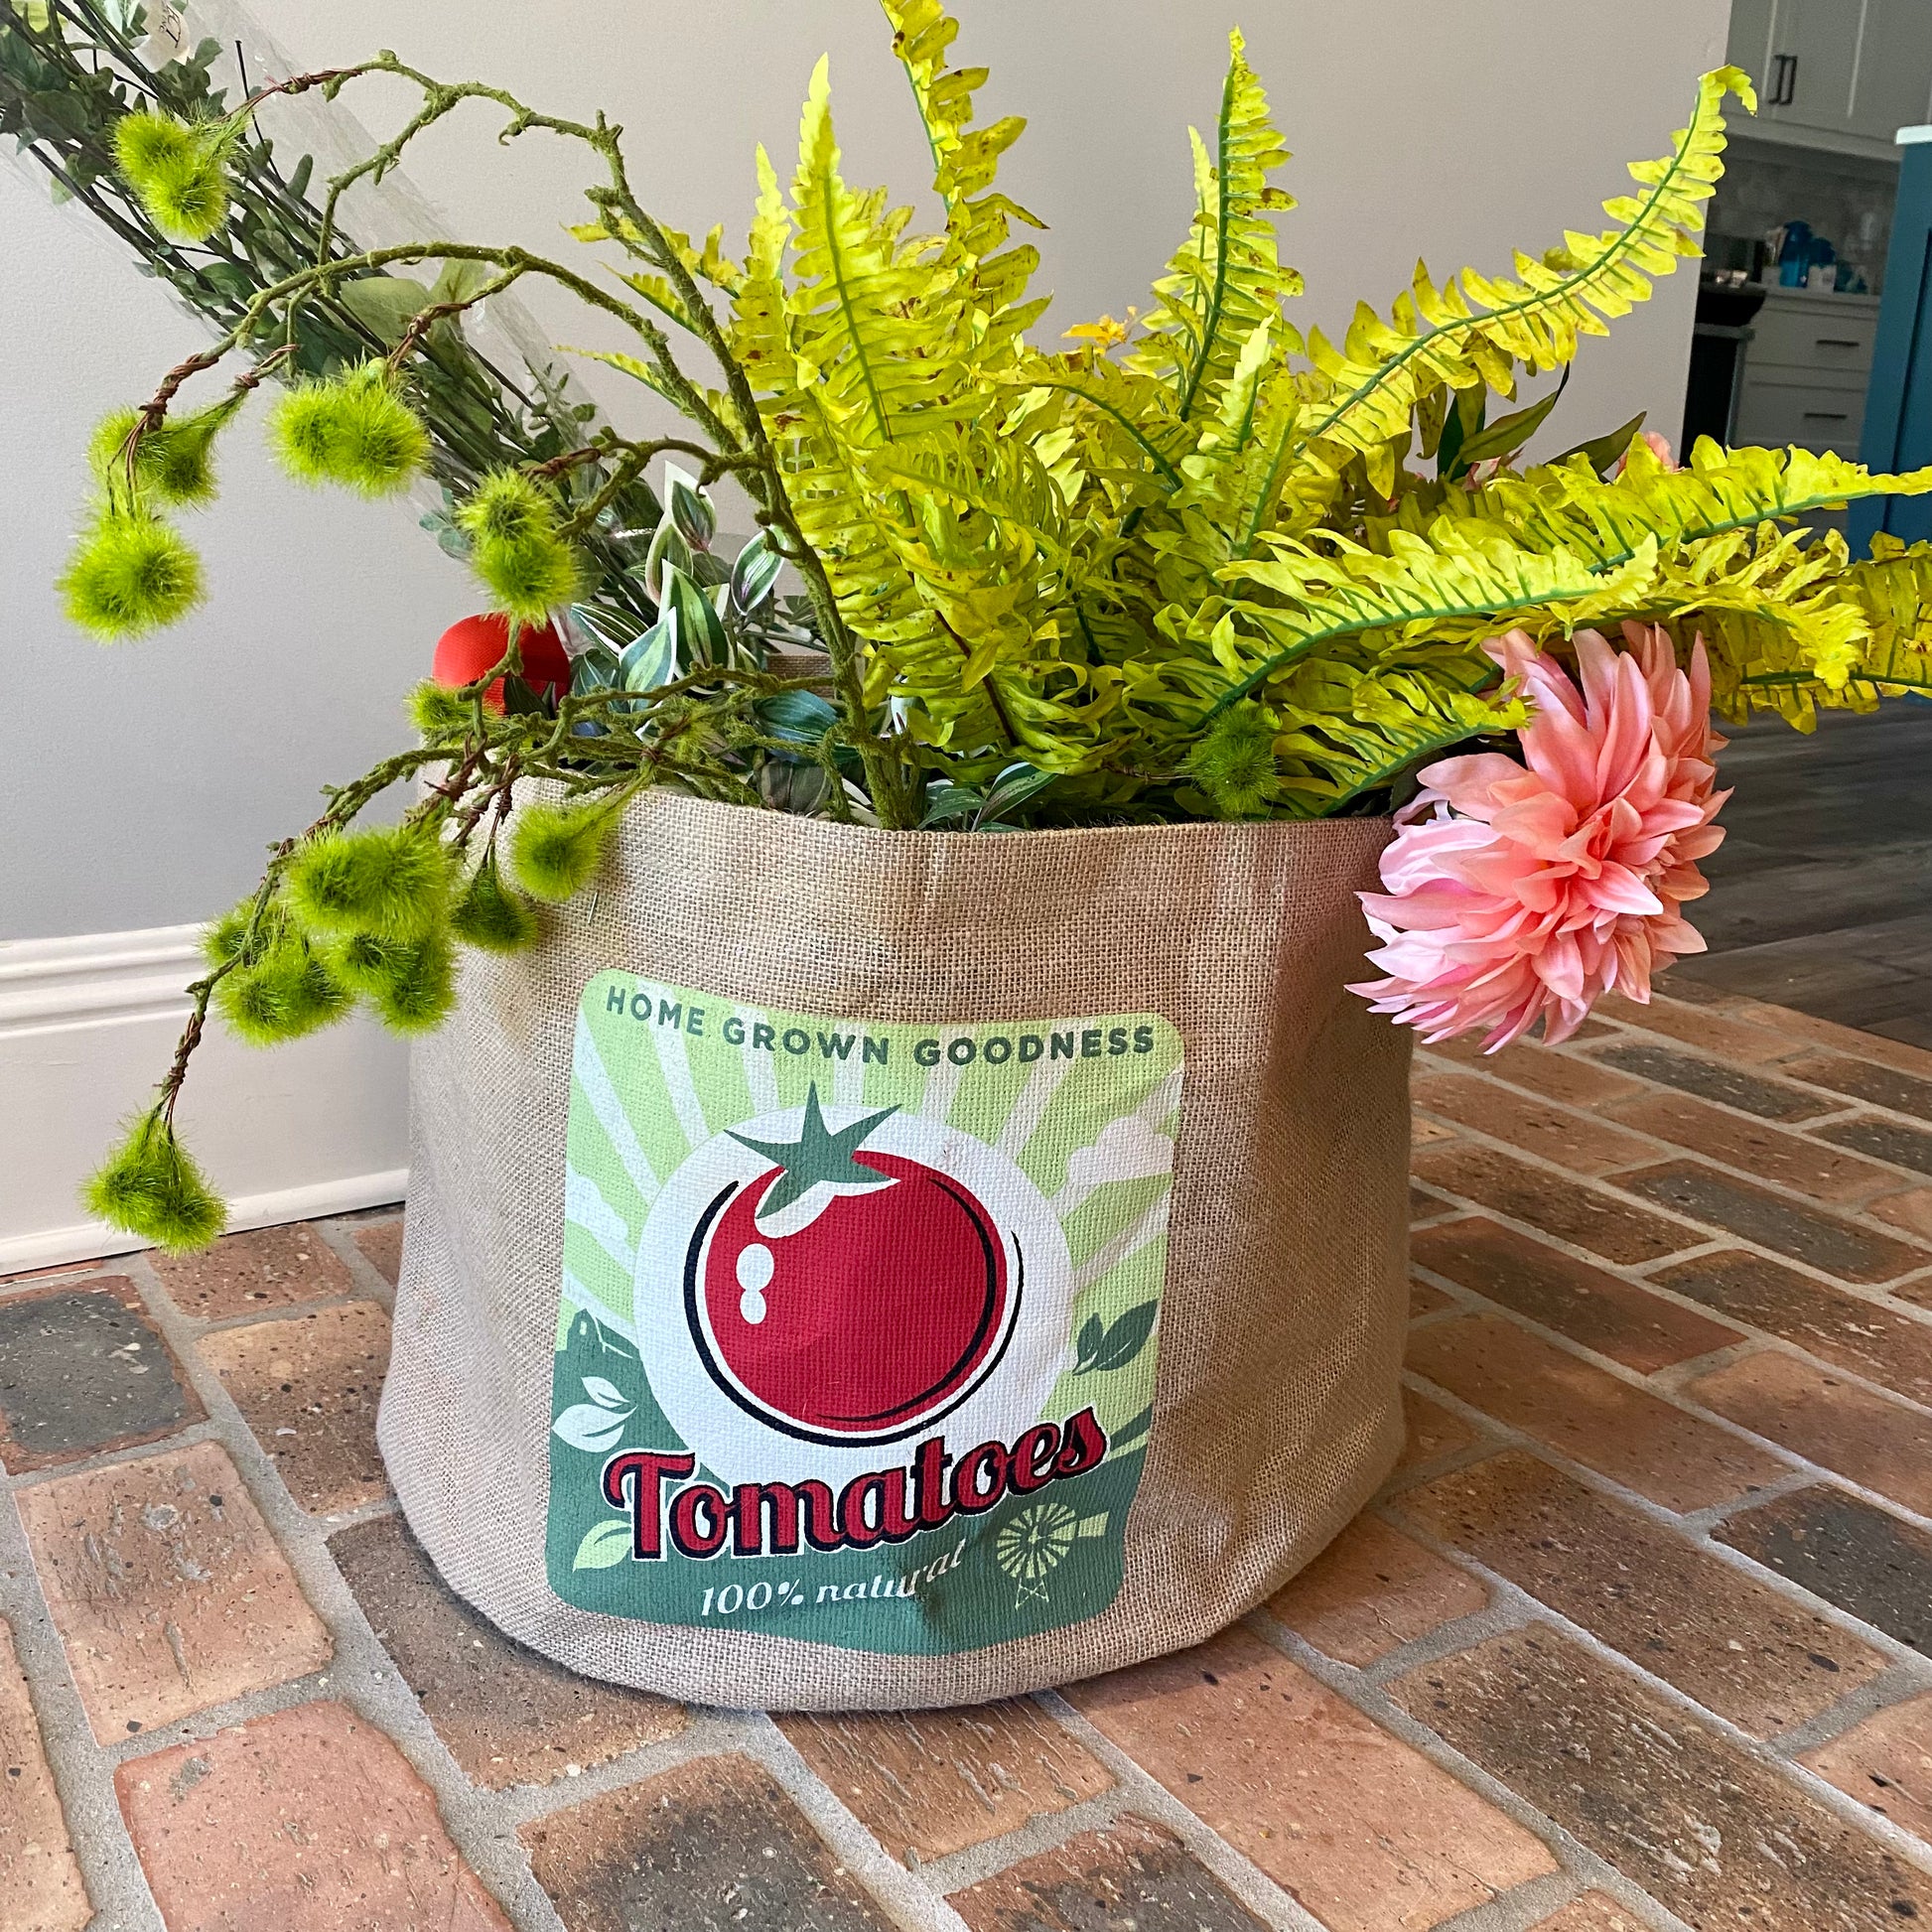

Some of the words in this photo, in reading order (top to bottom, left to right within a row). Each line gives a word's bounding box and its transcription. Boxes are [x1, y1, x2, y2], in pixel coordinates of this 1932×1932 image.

[607, 985, 705, 1035] HOME
[723, 1017, 889, 1065] GROWN
[913, 1026, 1154, 1066] GOODNESS
[602, 1405, 1107, 1561] Tomatoes
[701, 1579, 804, 1615] 100%
[815, 1538, 967, 1602] natural
